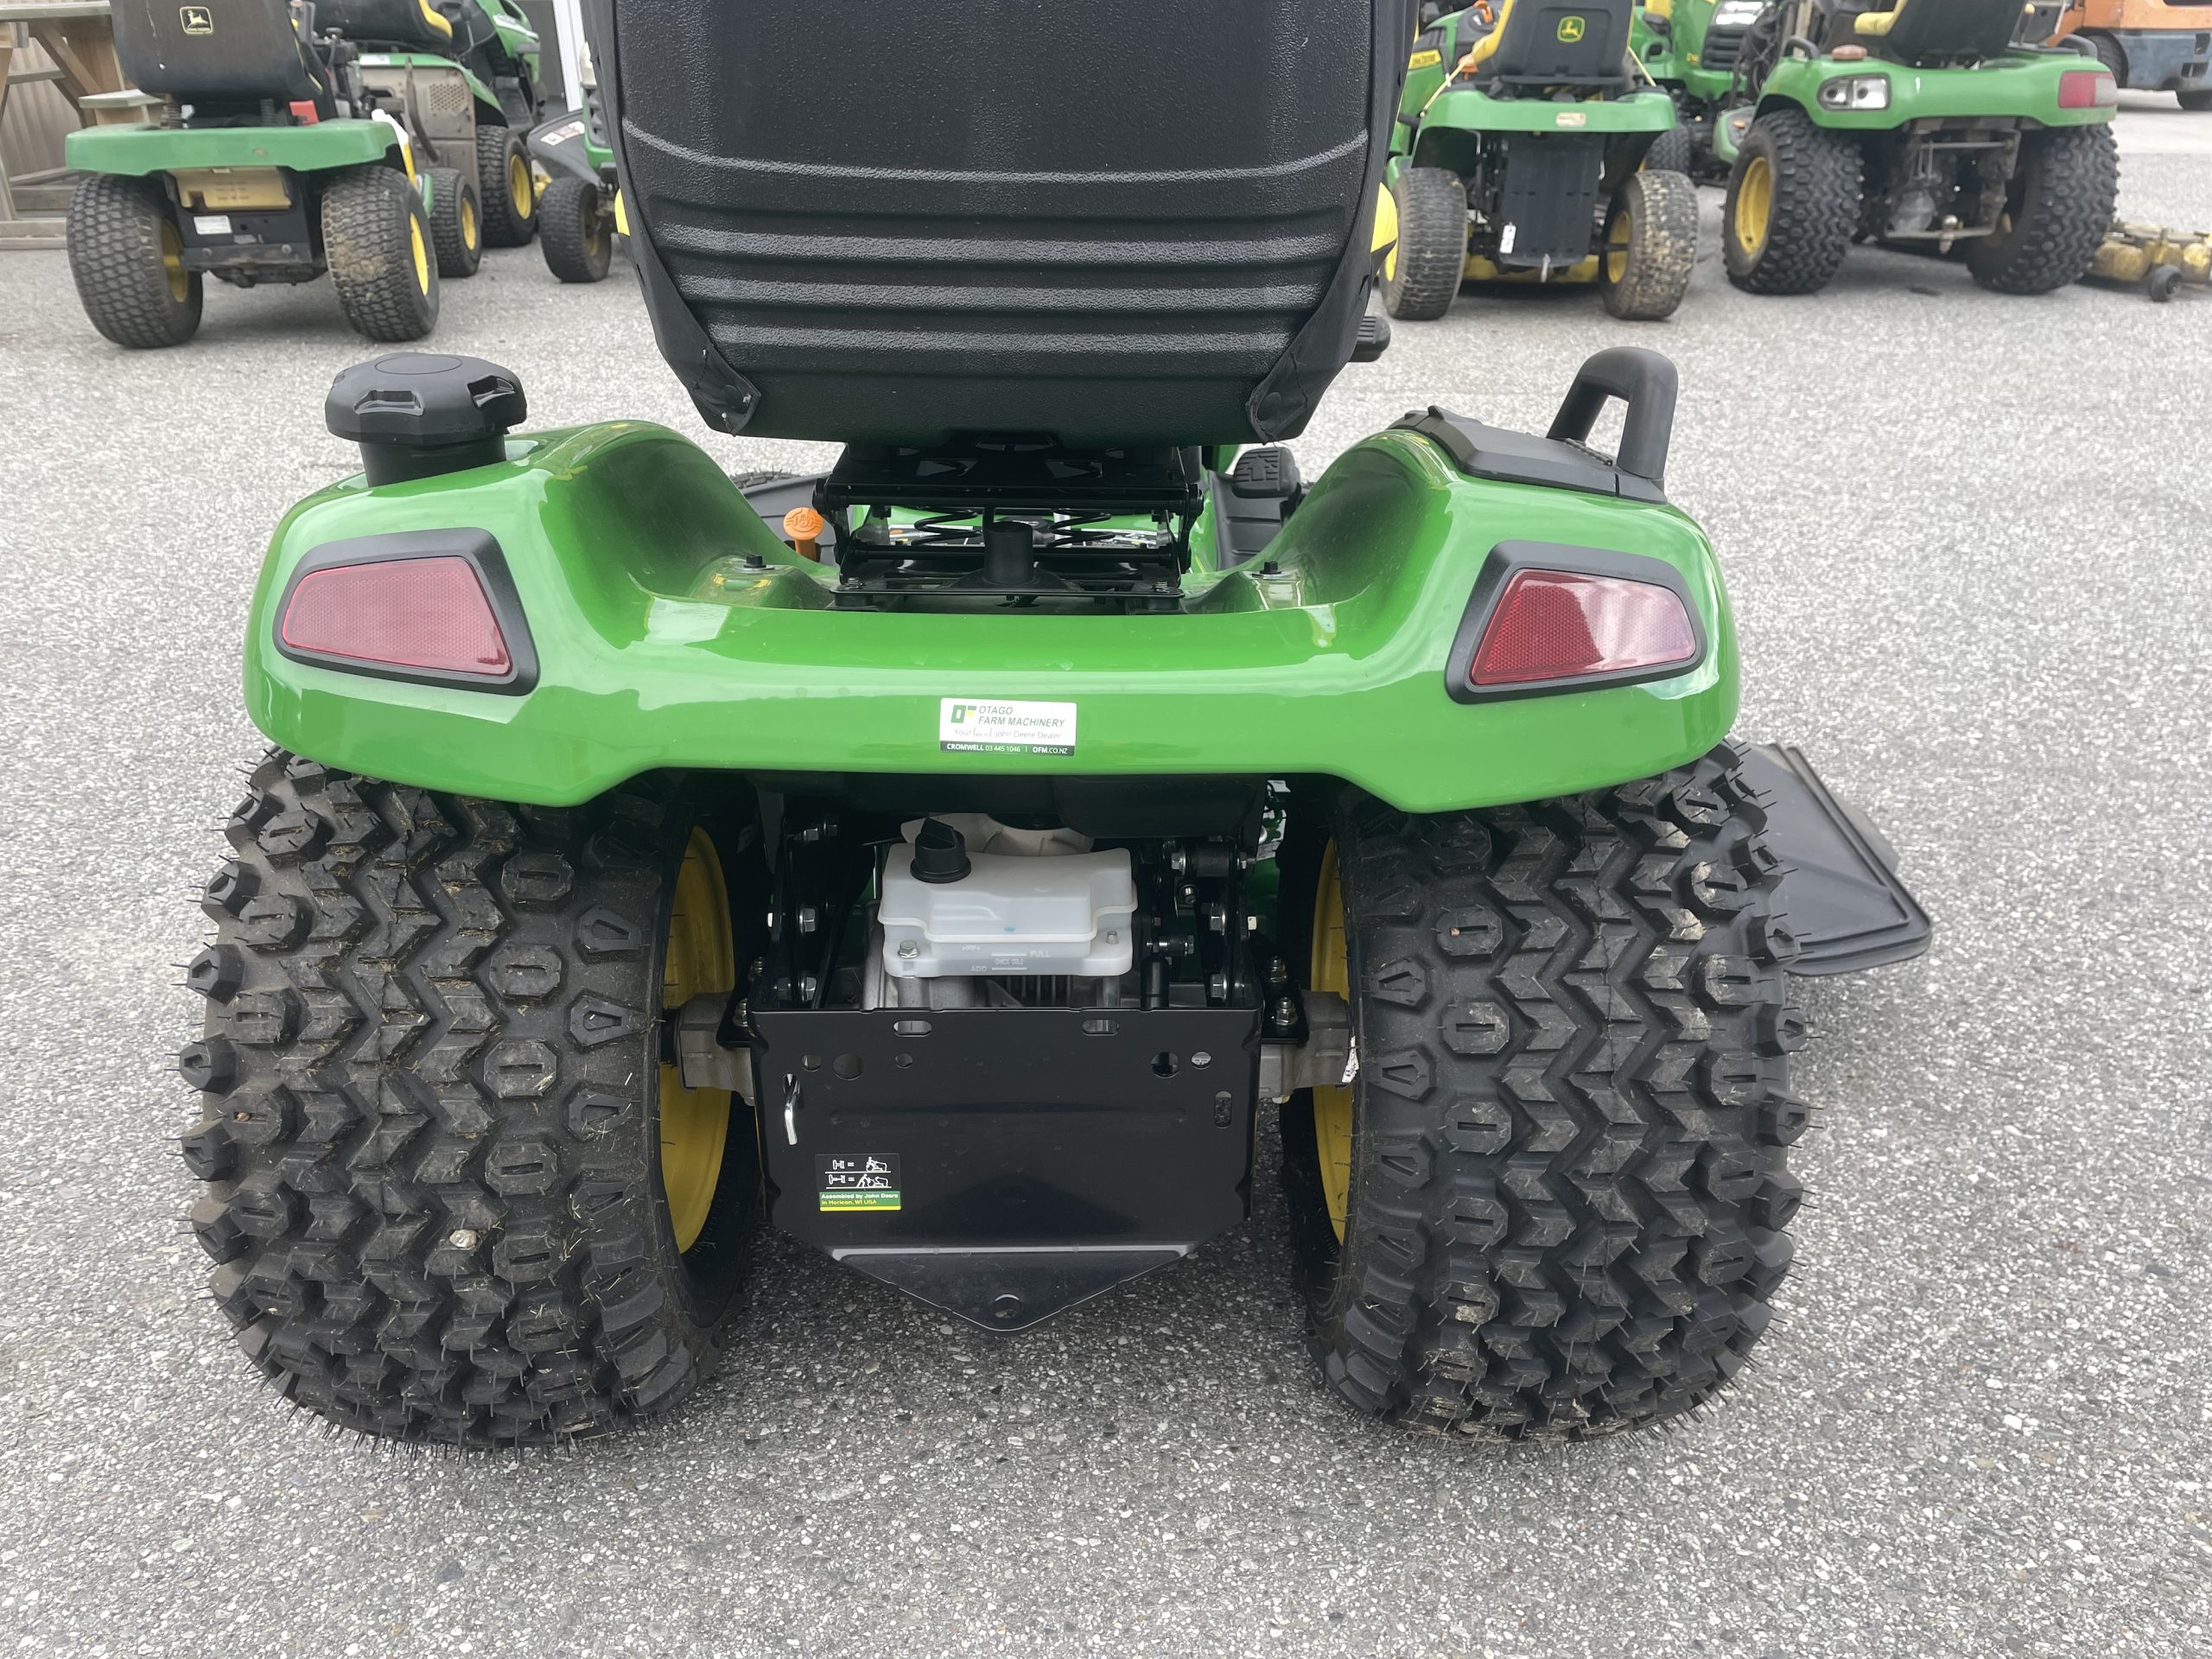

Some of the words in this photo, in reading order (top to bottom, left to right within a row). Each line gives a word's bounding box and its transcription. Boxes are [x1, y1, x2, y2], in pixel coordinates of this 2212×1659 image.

[978, 705, 1013, 715] OTAGO
[978, 716, 1006, 725] FARM
[1007, 717, 1065, 728] MACHINERY
[1037, 731, 1061, 740] Dealer
[946, 743, 984, 752] CROMWELL
[1032, 746, 1068, 754] OFM.CO.NZ
